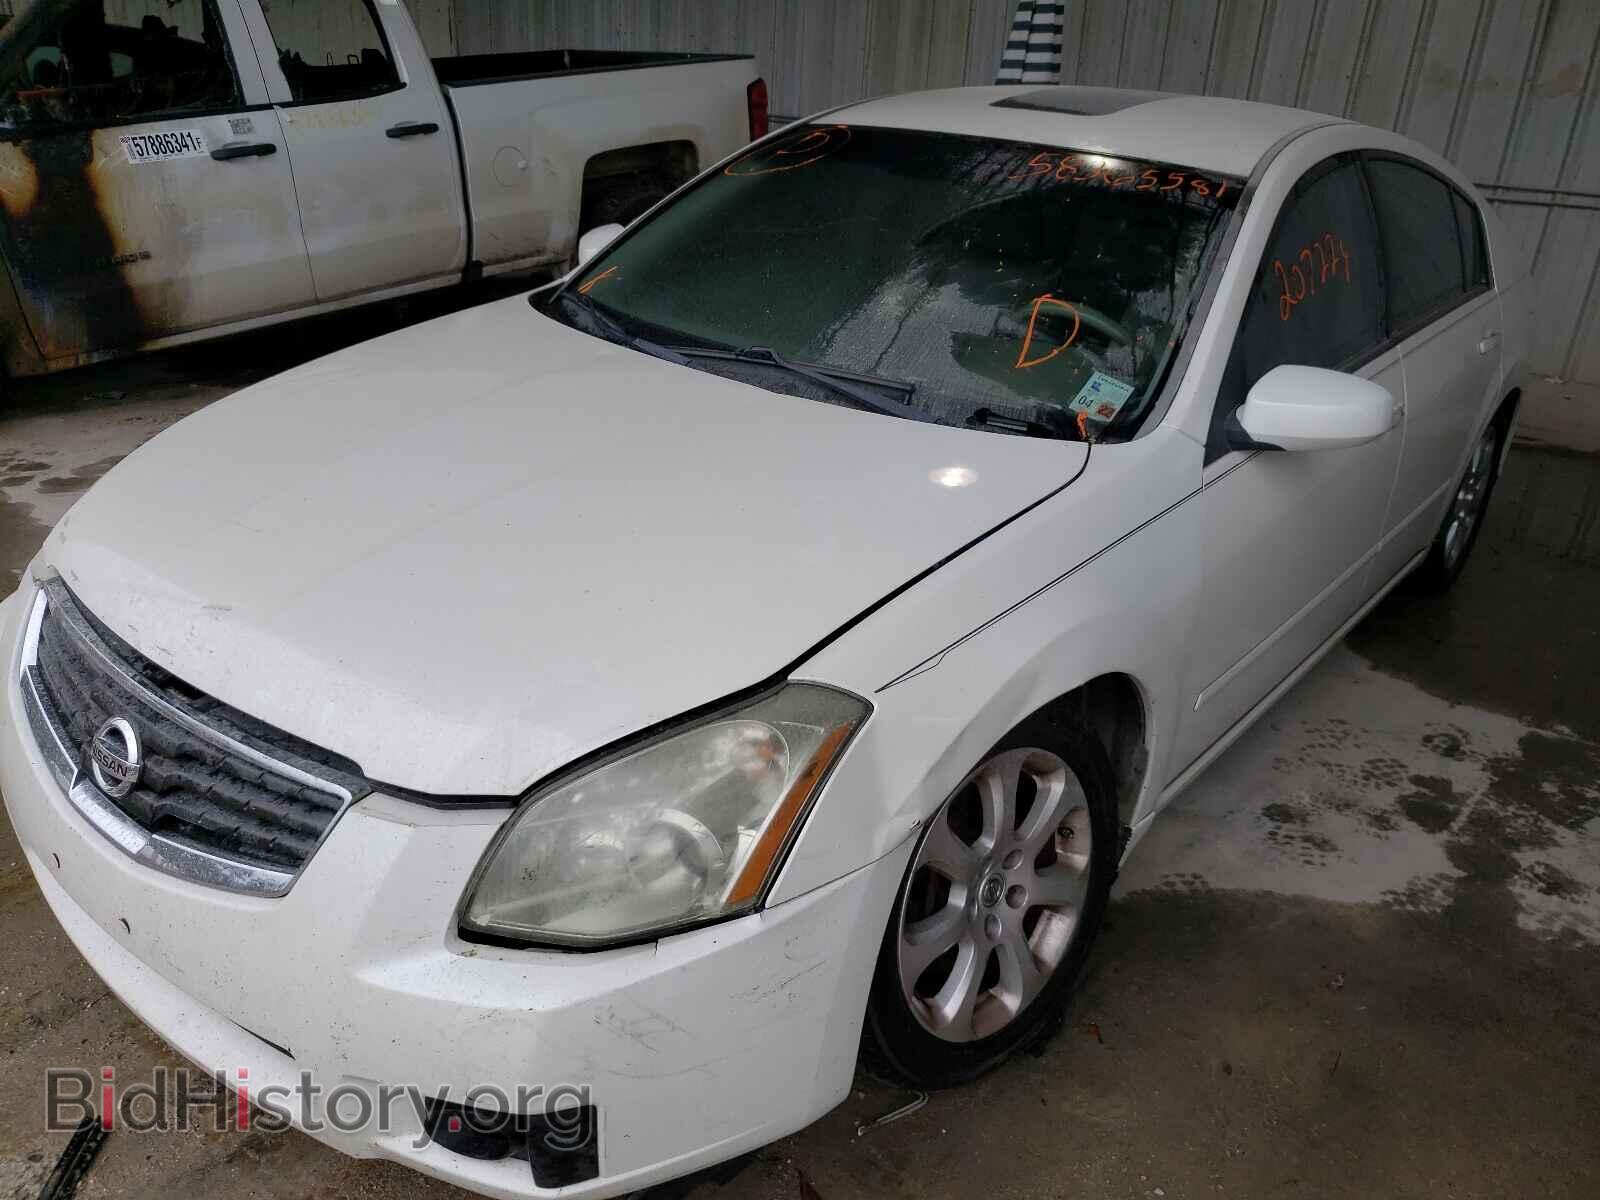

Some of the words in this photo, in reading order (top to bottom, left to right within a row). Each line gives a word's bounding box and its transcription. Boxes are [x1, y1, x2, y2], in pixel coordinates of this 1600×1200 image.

[131, 132, 197, 157] 57886341
[1015, 293, 1080, 369] D
[93, 745, 128, 777] NISSAN
